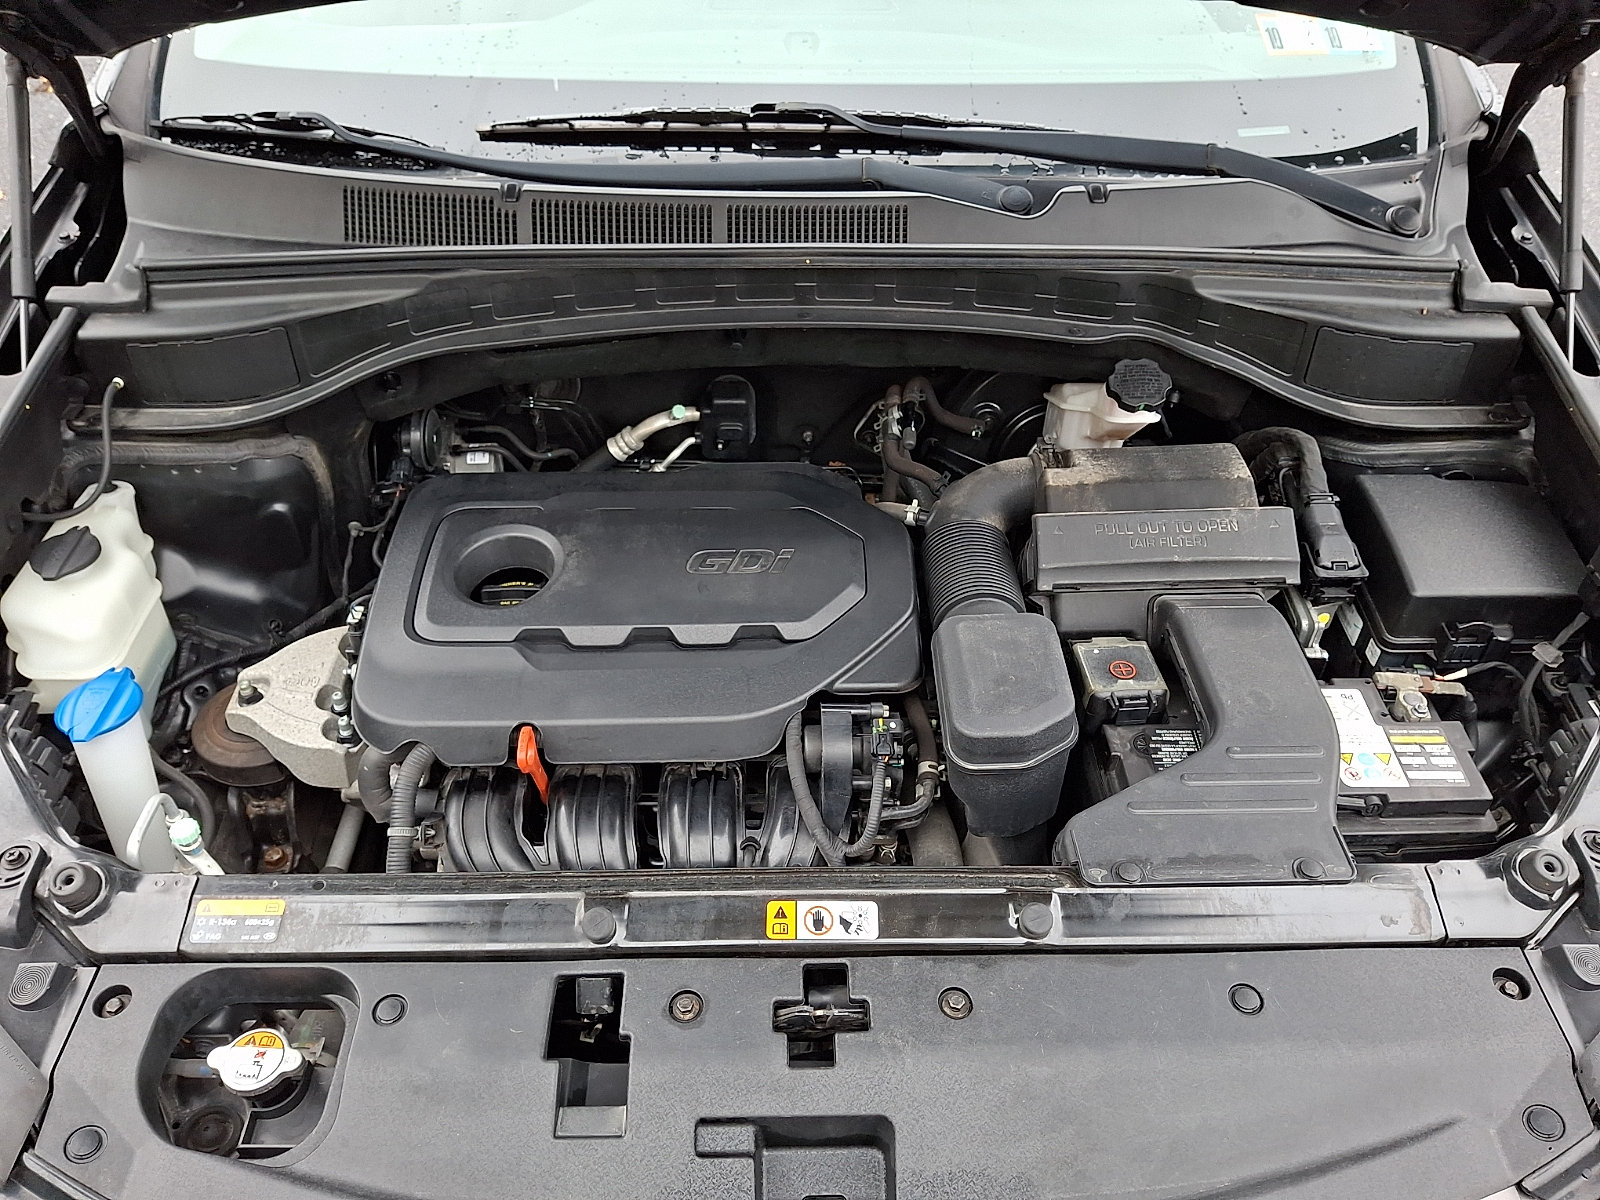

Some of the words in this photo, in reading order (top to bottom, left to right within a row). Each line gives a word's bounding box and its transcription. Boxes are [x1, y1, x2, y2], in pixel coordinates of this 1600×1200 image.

[1265, 27, 1284, 49] 10
[1324, 26, 1343, 49] 10
[1095, 522, 1134, 535] PULL
[1137, 519, 1169, 534] OUT
[1172, 519, 1193, 533] TO
[1197, 518, 1239, 533] OPEN
[1159, 534, 1208, 548] FILTER)
